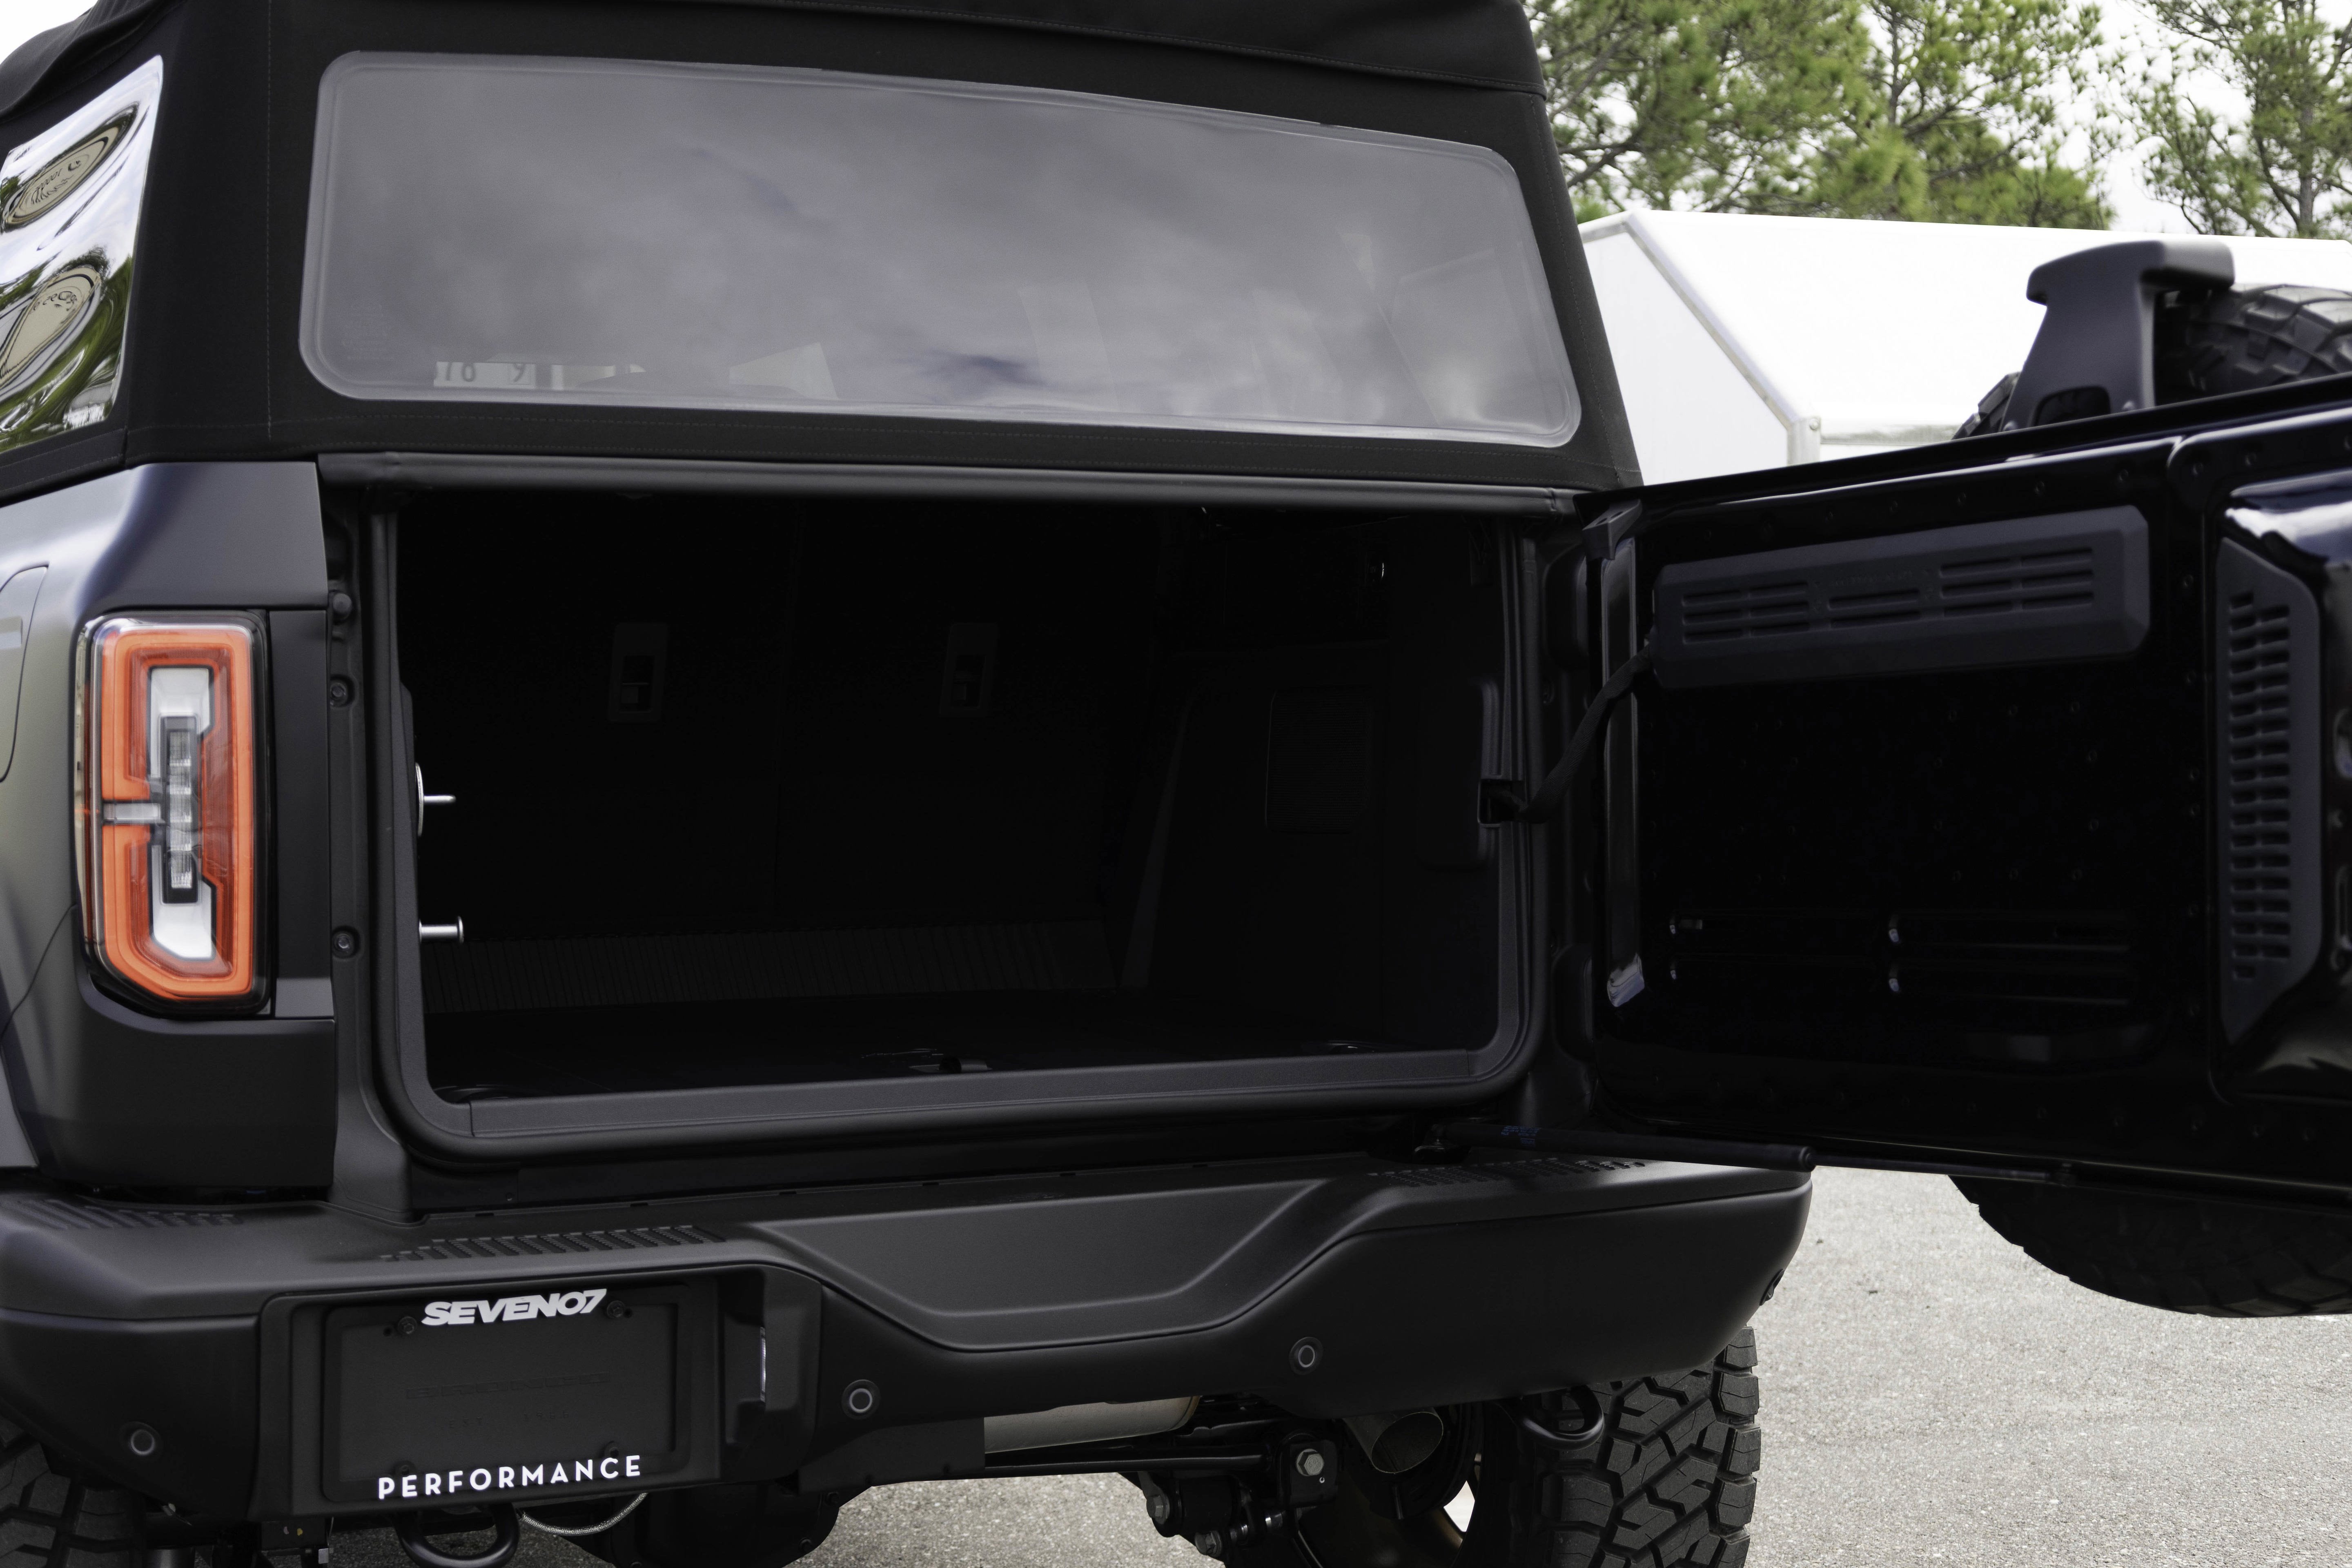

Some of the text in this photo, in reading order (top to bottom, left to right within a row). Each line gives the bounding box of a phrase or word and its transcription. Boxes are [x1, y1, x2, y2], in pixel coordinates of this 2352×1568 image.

[406, 1372, 611, 1399] BRONCO
[523, 1410, 570, 1423] 1966
[378, 1454, 641, 1500] PERFORMANCE
